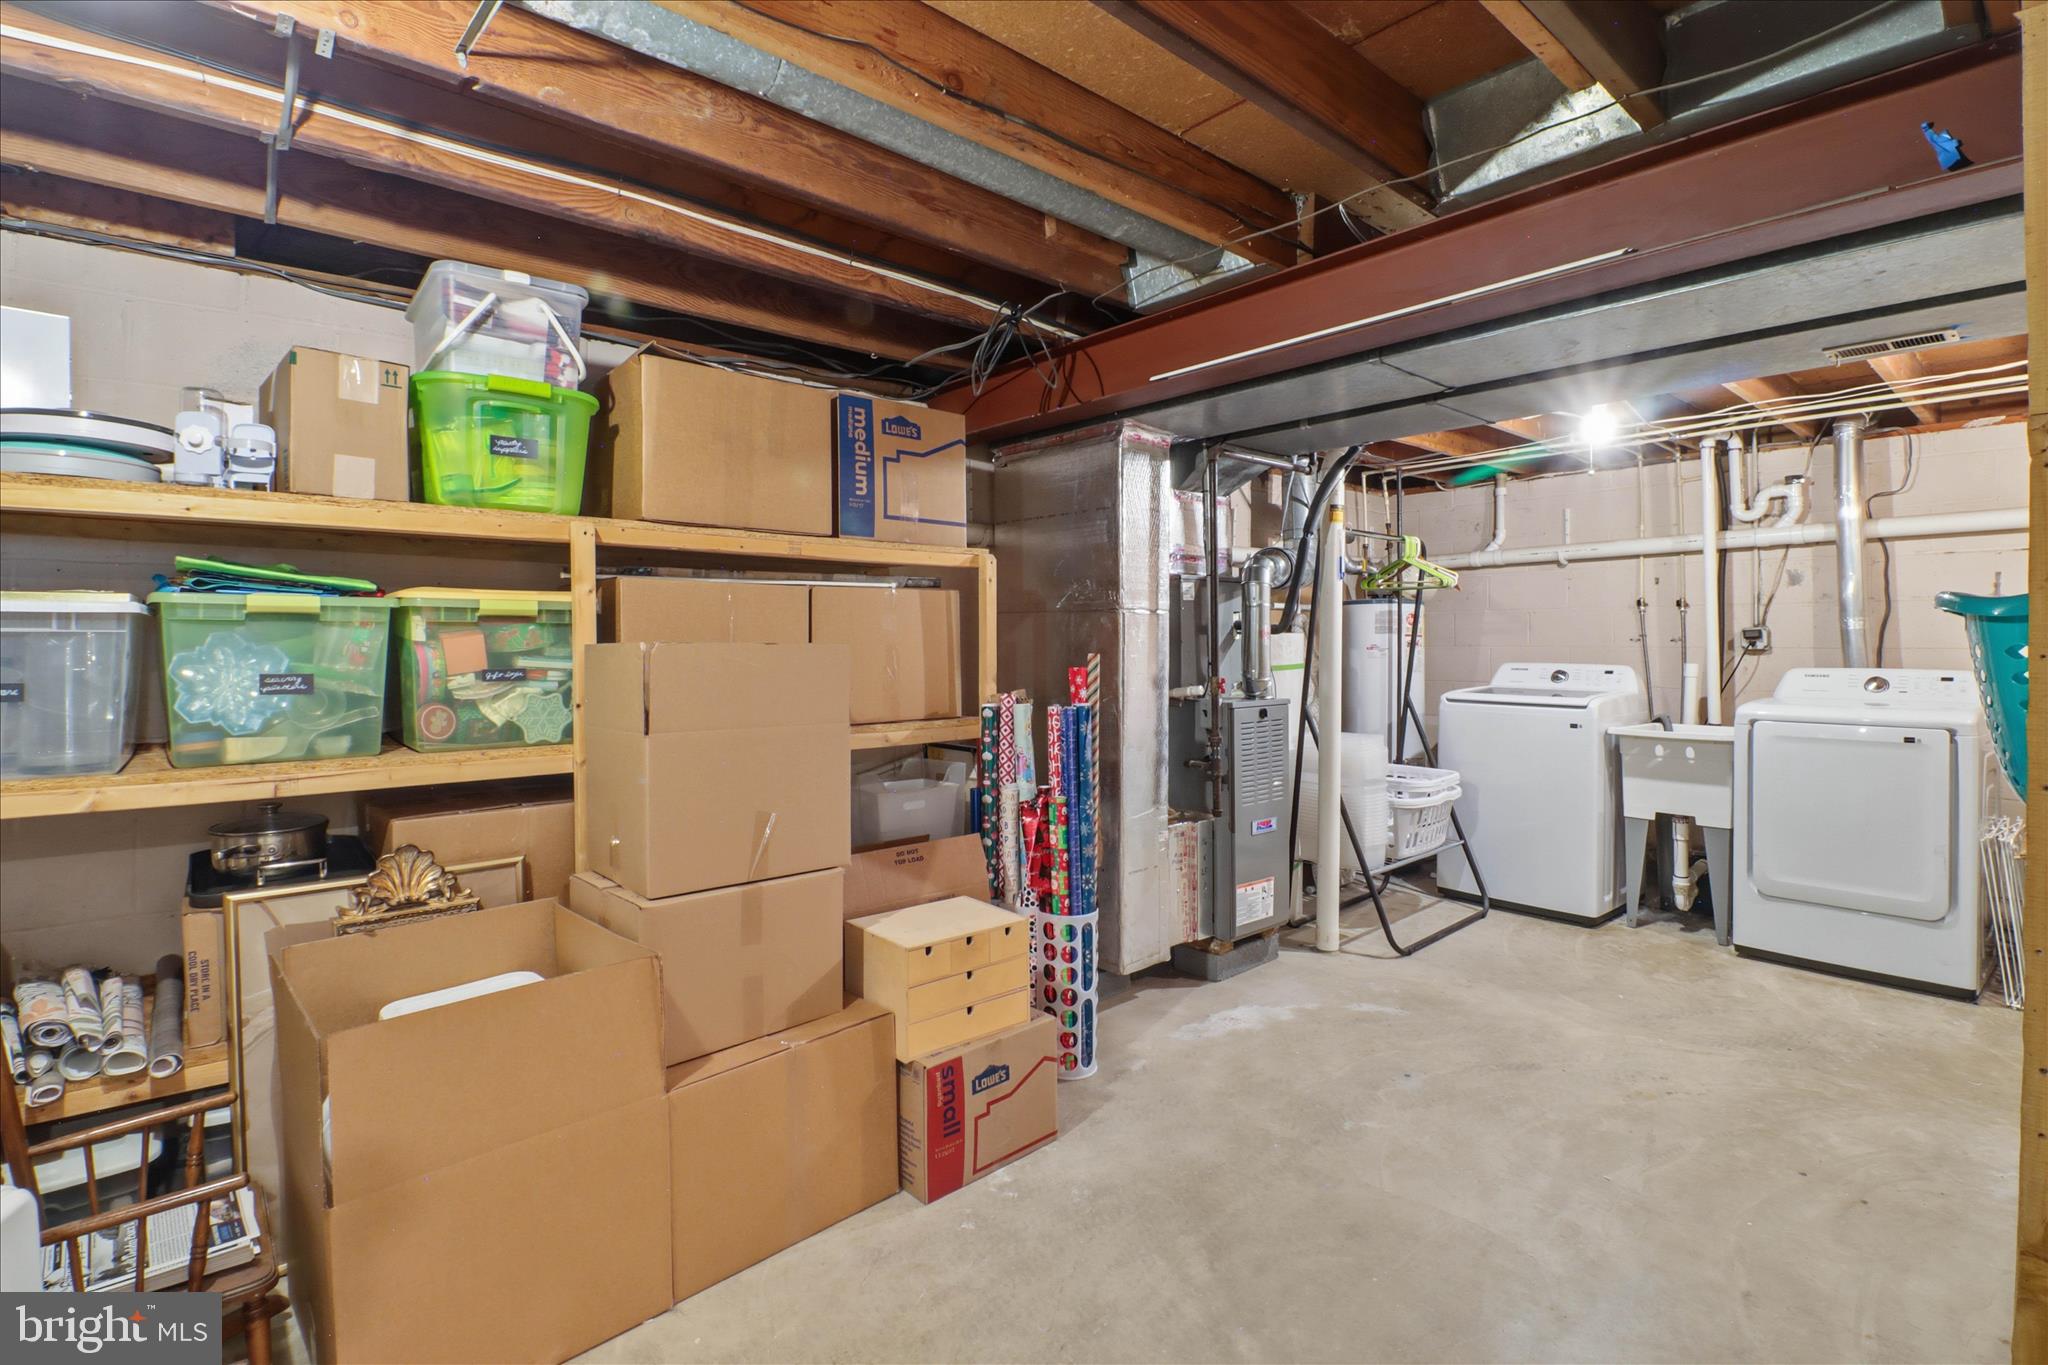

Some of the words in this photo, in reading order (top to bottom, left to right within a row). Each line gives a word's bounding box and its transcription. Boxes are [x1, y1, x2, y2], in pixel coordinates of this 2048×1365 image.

[885, 422, 918, 438] LOWE'S
[854, 407, 871, 496] medium
[188, 951, 197, 971] COOL
[201, 984, 211, 993] IN
[975, 1069, 1007, 1091] LOWE'S
[942, 1065, 961, 1138] small
